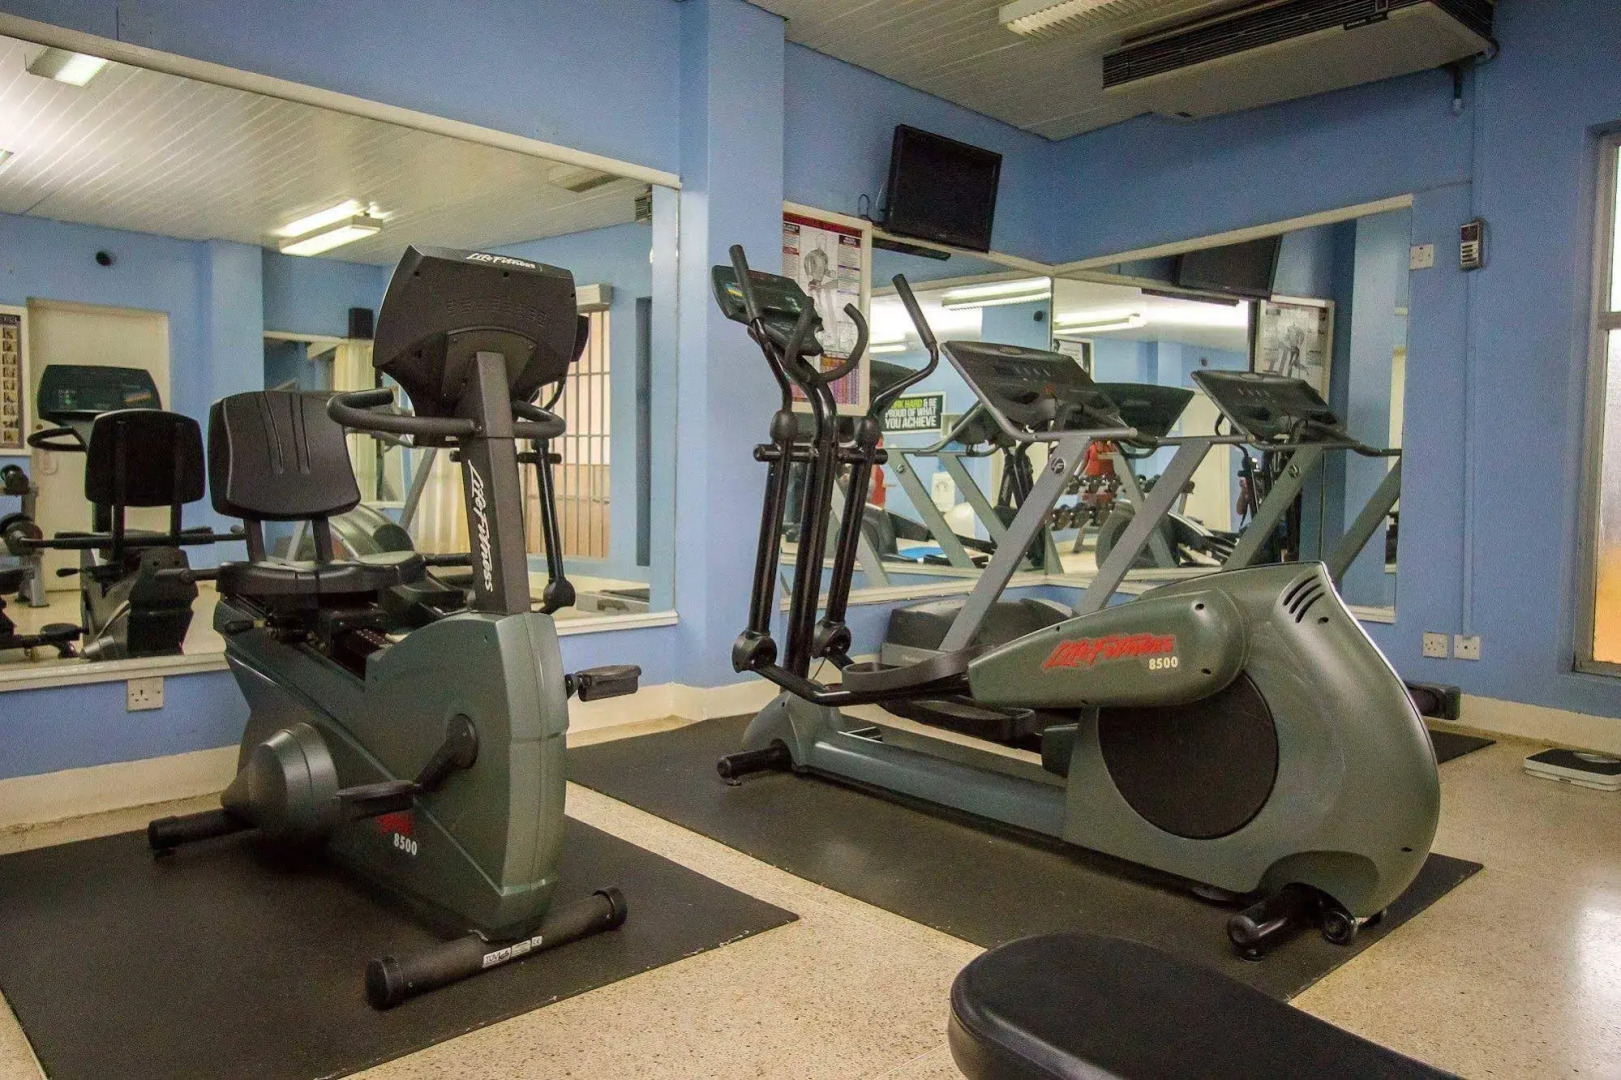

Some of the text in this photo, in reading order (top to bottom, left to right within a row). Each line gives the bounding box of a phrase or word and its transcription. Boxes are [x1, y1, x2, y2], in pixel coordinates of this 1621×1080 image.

[907, 408, 916, 417] OF
[917, 406, 937, 416] WHAT
[885, 415, 937, 429] YOU ACHIEVE
[1148, 656, 1179, 670] 8500
[393, 832, 418, 856] 8500
